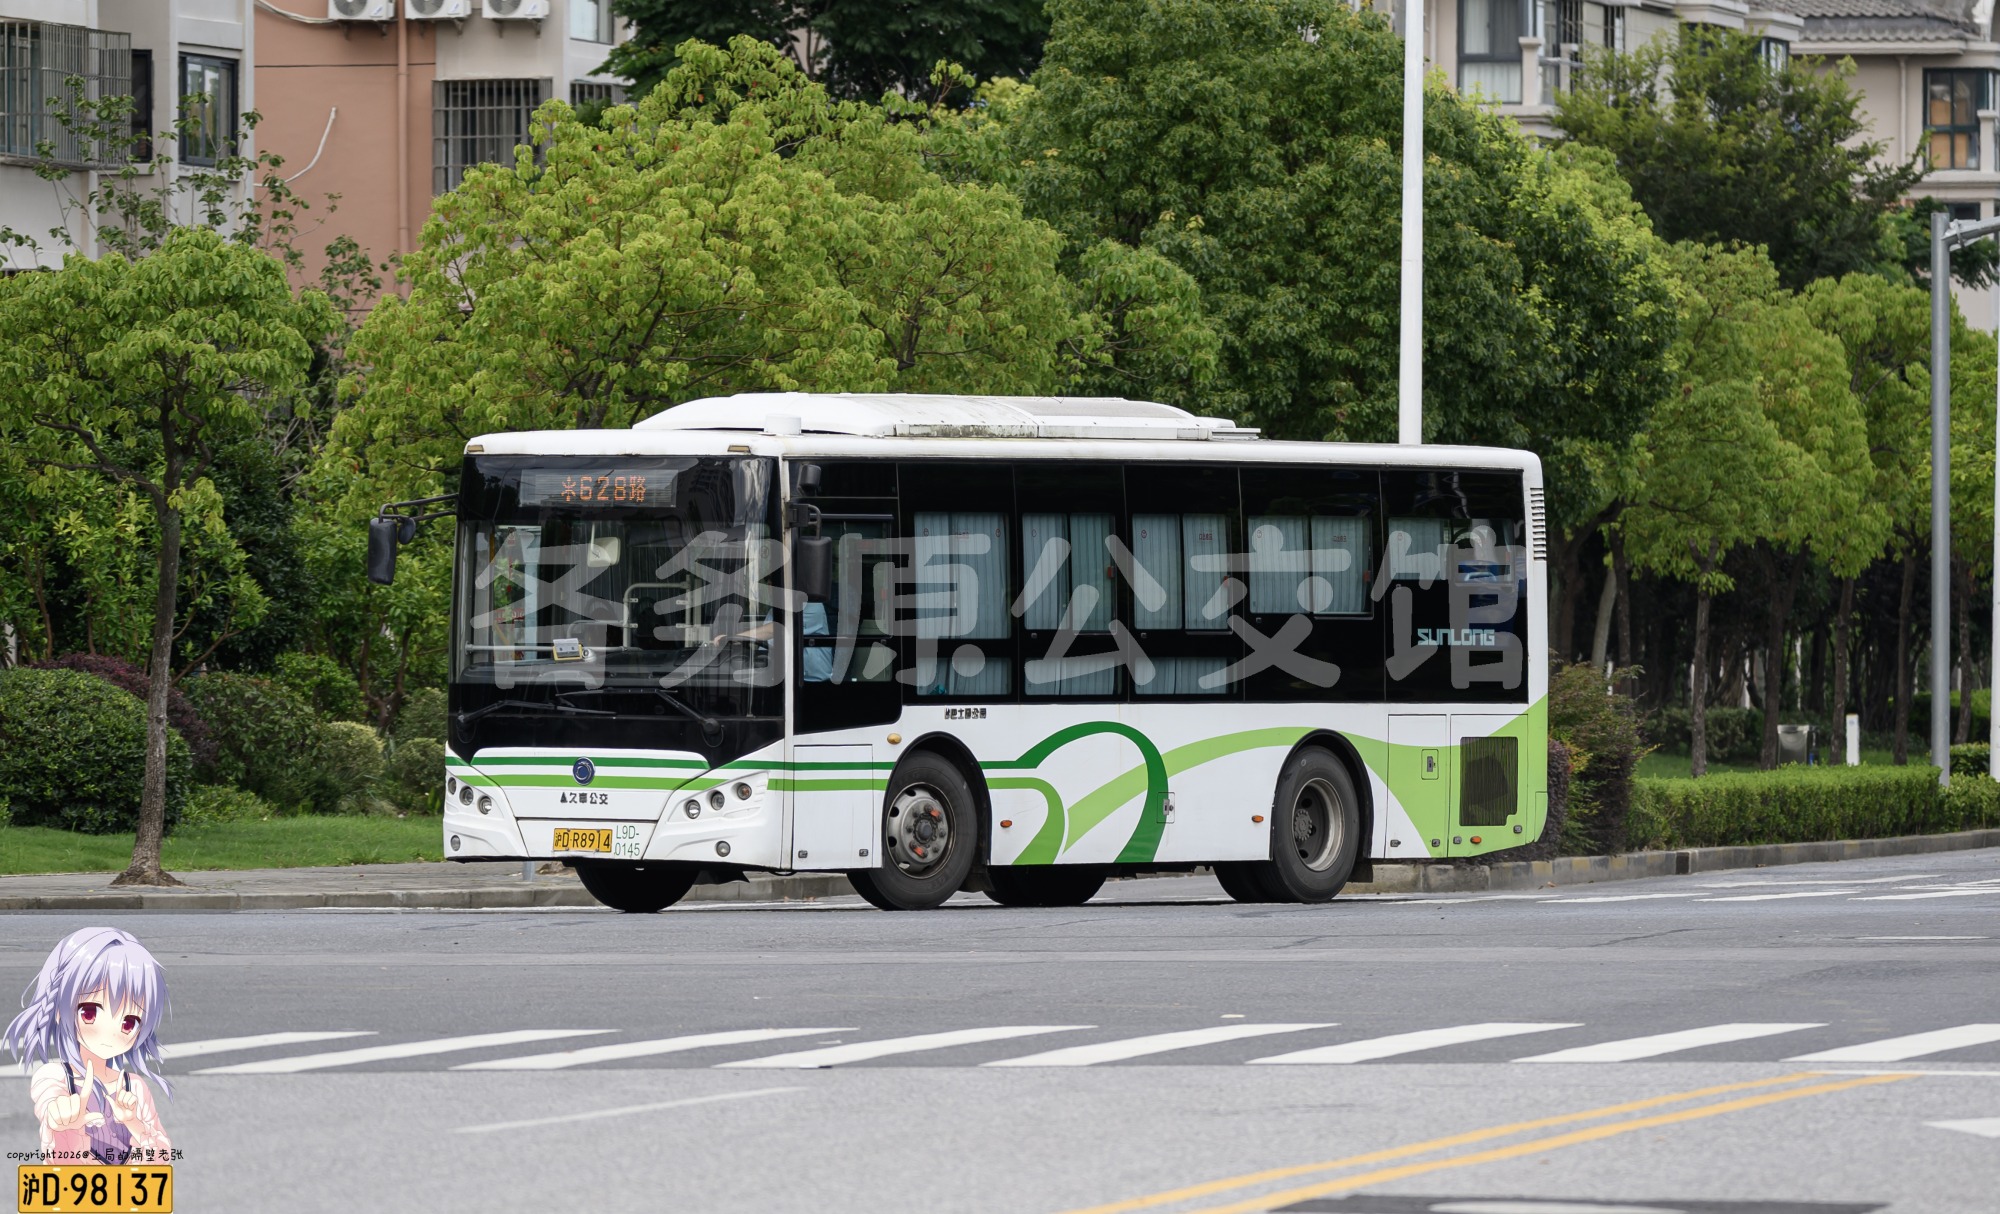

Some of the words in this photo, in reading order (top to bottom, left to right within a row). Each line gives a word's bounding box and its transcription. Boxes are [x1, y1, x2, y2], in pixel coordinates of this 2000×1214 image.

[1417, 628, 1495, 646] SUNLONG
[616, 825, 640, 840] L9D-
[614, 842, 641, 857] 0145
